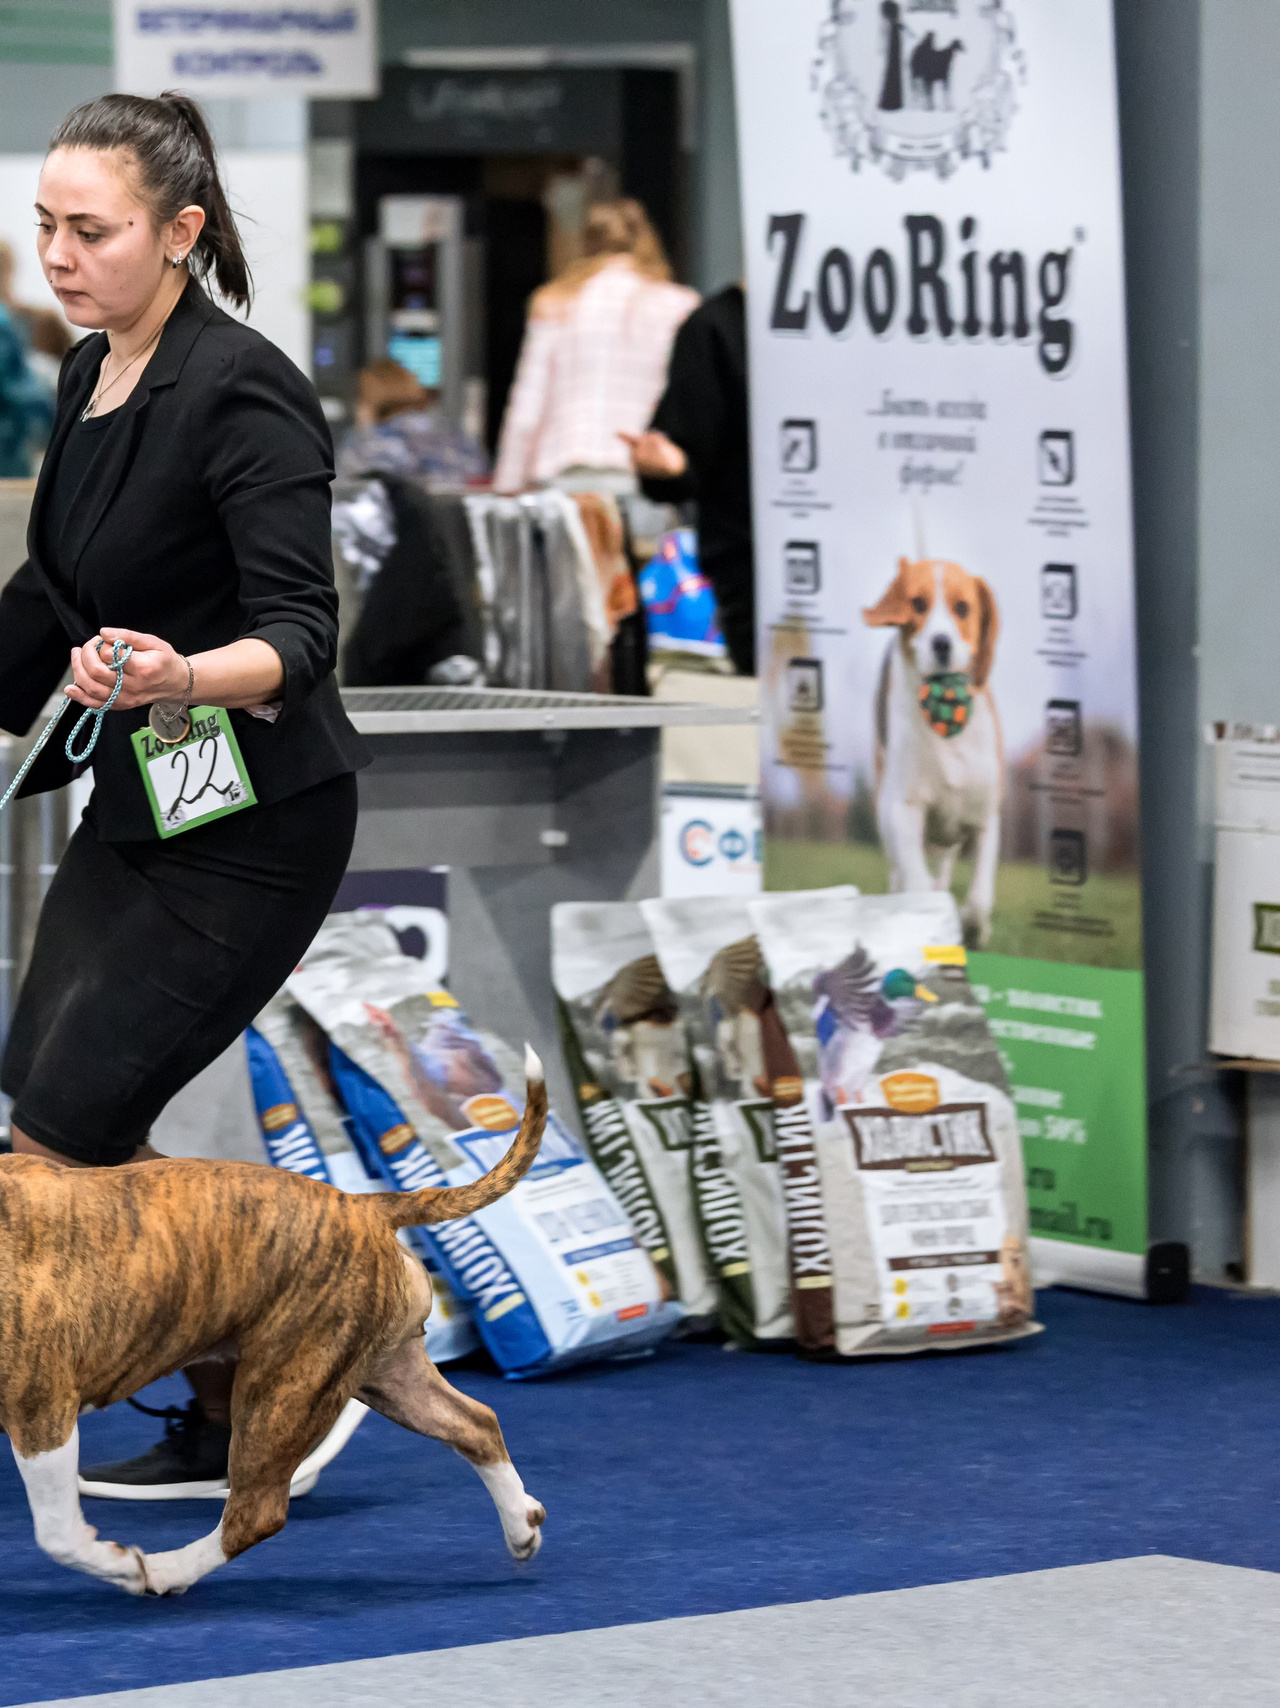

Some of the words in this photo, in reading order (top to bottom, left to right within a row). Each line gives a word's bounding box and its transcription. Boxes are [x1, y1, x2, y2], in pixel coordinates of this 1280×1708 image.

[766, 211, 1076, 379] ZooRing
[141, 713, 223, 759] Zoing
[167, 735, 235, 822] 22
